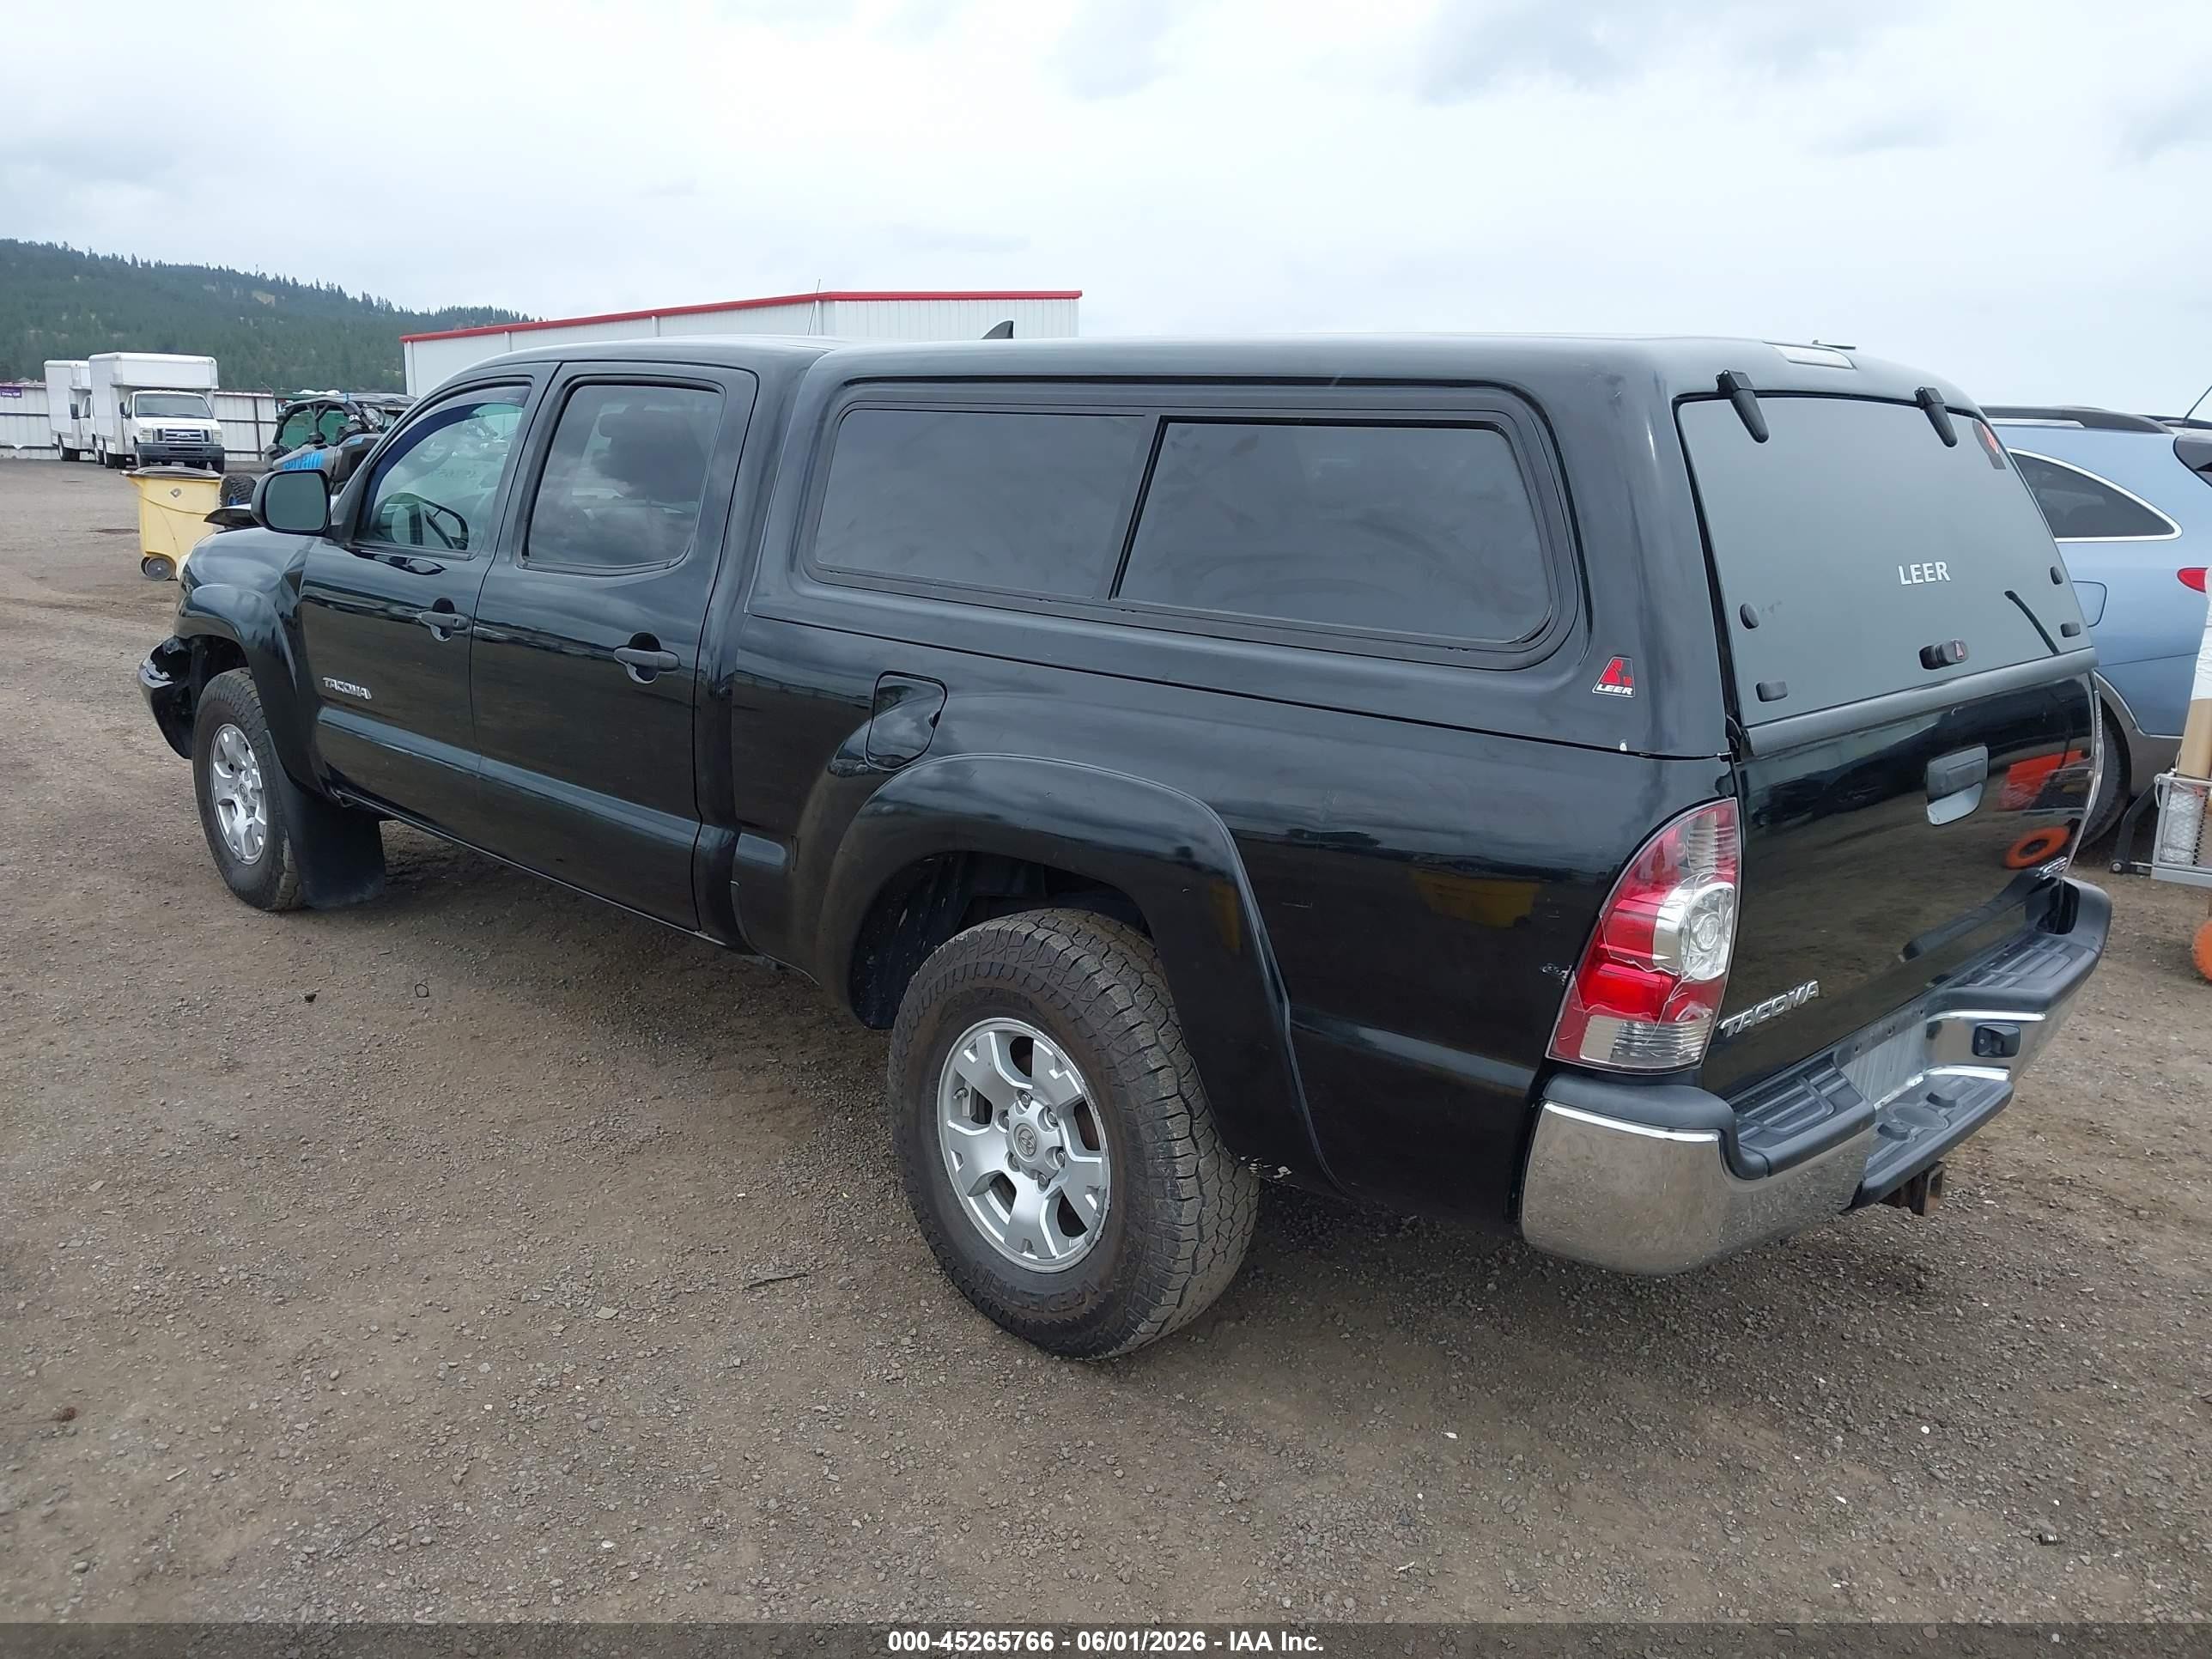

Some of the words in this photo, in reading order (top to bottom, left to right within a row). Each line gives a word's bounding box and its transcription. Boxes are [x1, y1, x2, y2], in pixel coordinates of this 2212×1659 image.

[1898, 561, 1951, 585] LEER
[322, 677, 372, 700] TACOMA
[1595, 684, 1633, 696] LEER
[1717, 979, 1820, 1038] TACOMA
